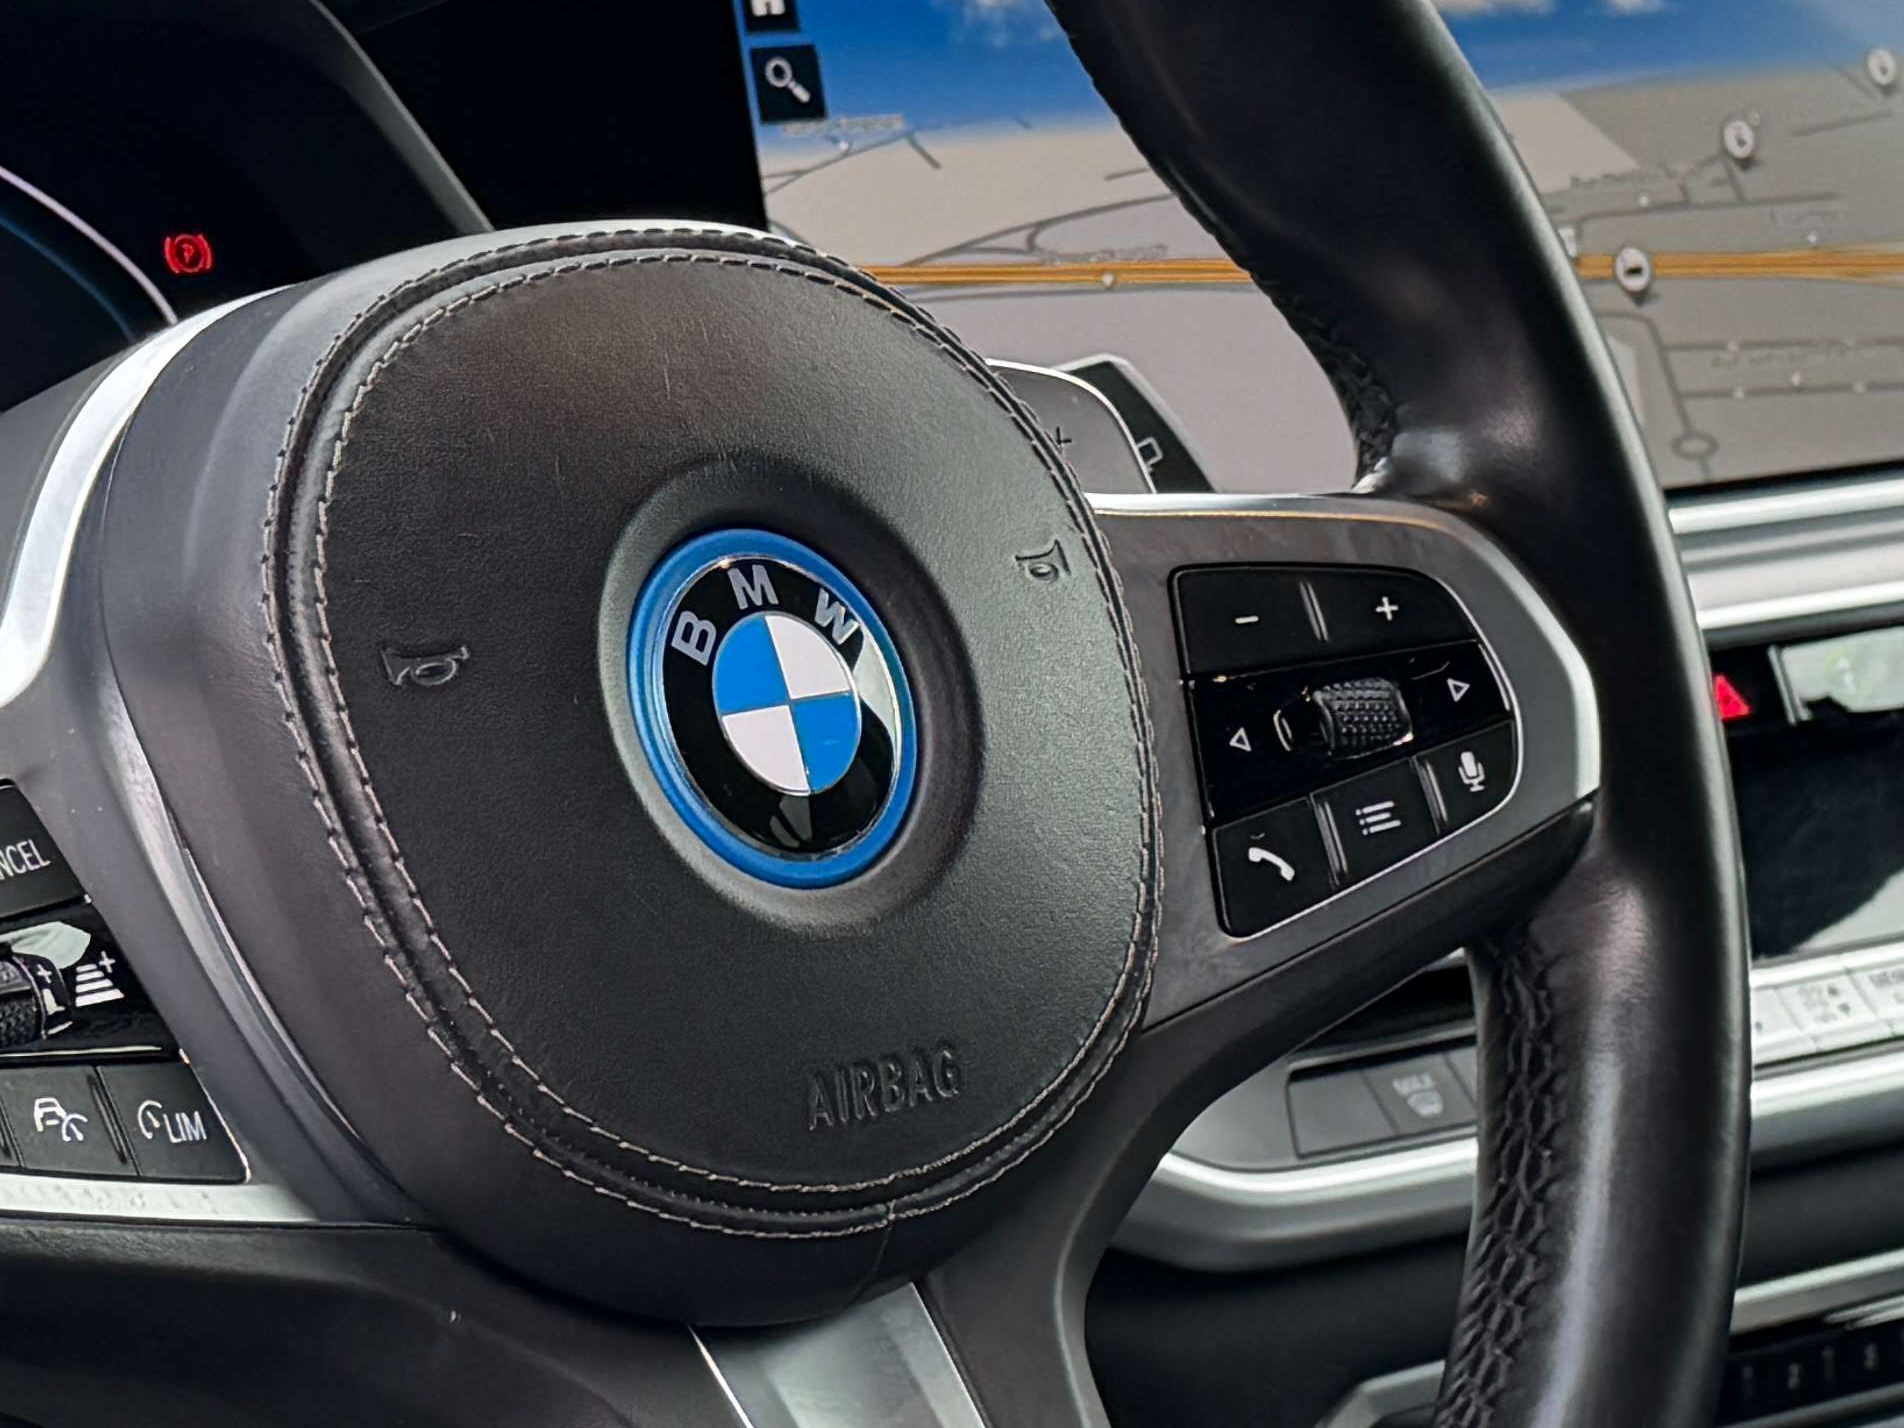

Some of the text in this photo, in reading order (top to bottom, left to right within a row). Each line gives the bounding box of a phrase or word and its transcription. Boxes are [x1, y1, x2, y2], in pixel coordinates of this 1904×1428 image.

[670, 563, 863, 666] BMW
[163, 1110, 208, 1144] LIM
[806, 1038, 962, 1132] AIRBAG
